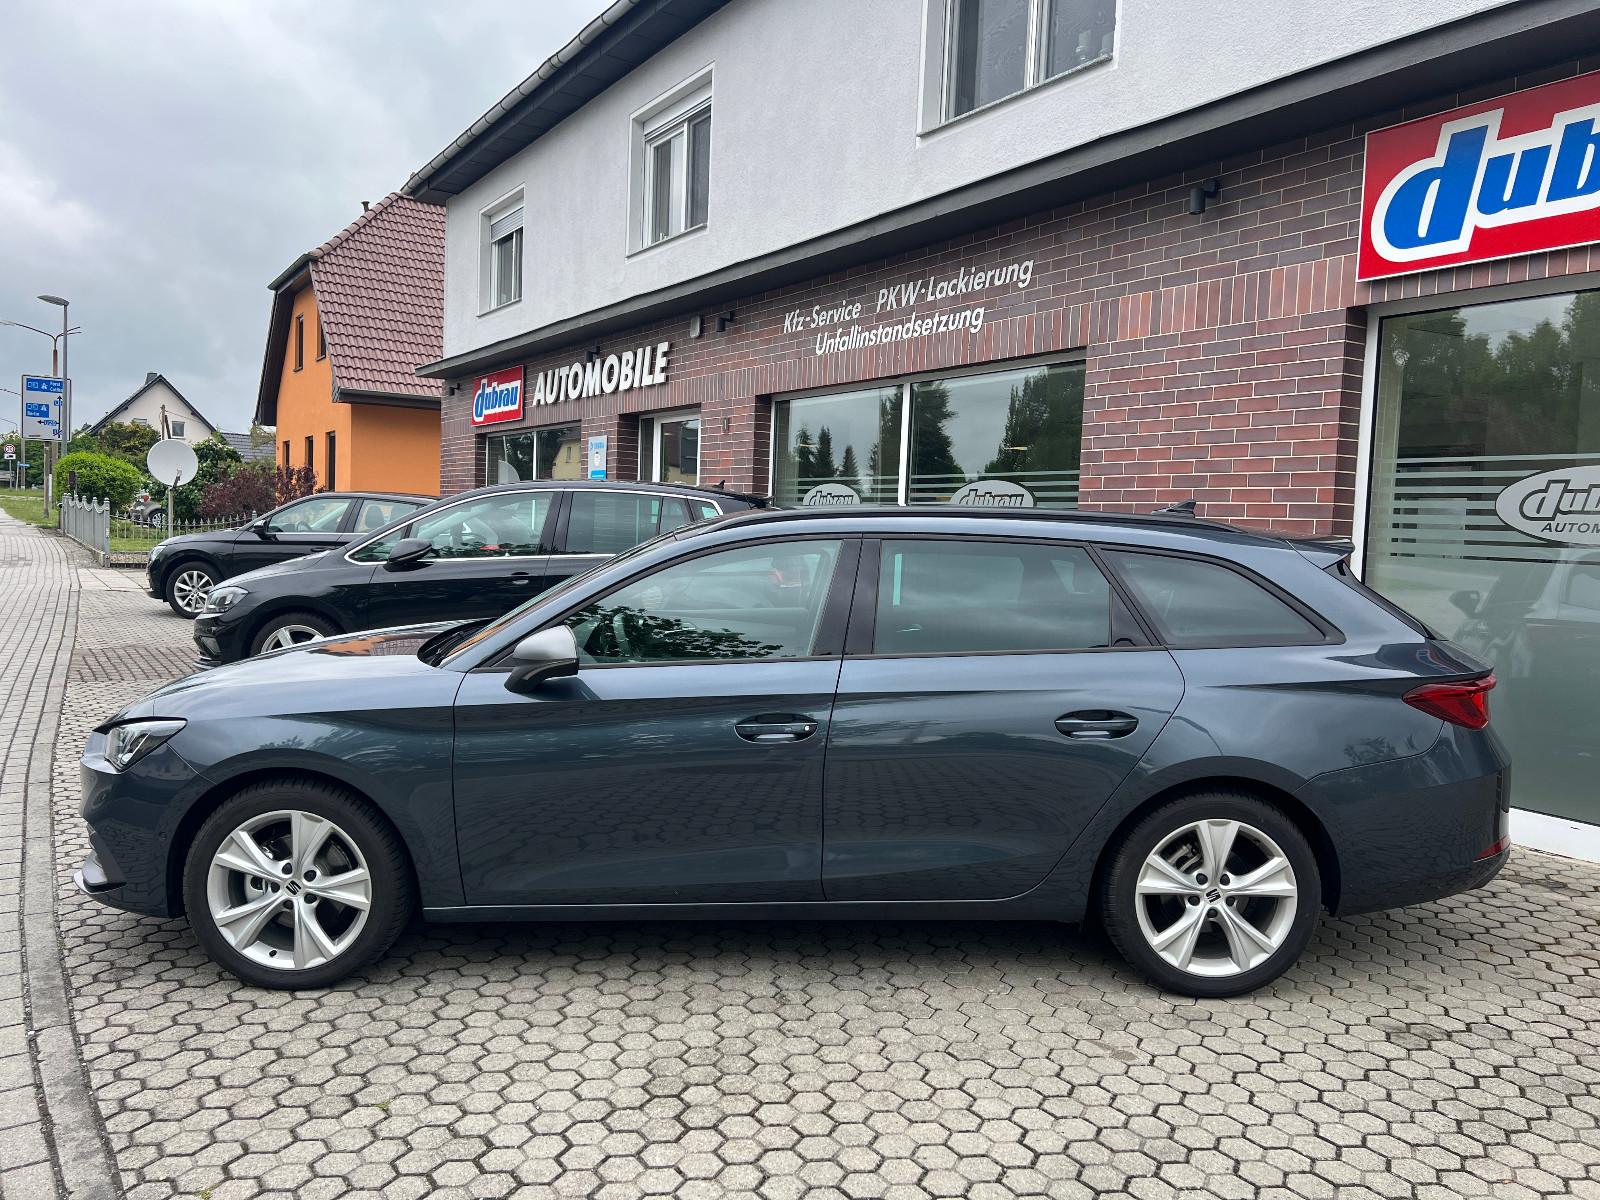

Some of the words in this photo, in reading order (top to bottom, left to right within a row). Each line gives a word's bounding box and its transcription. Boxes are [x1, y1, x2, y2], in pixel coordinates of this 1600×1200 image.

[783, 300, 862, 334] Kfz-Service
[815, 305, 985, 356] Unfallinstandsetzung
[532, 341, 670, 406] AUTOMOBILE
[473, 378, 521, 422] dubrau
